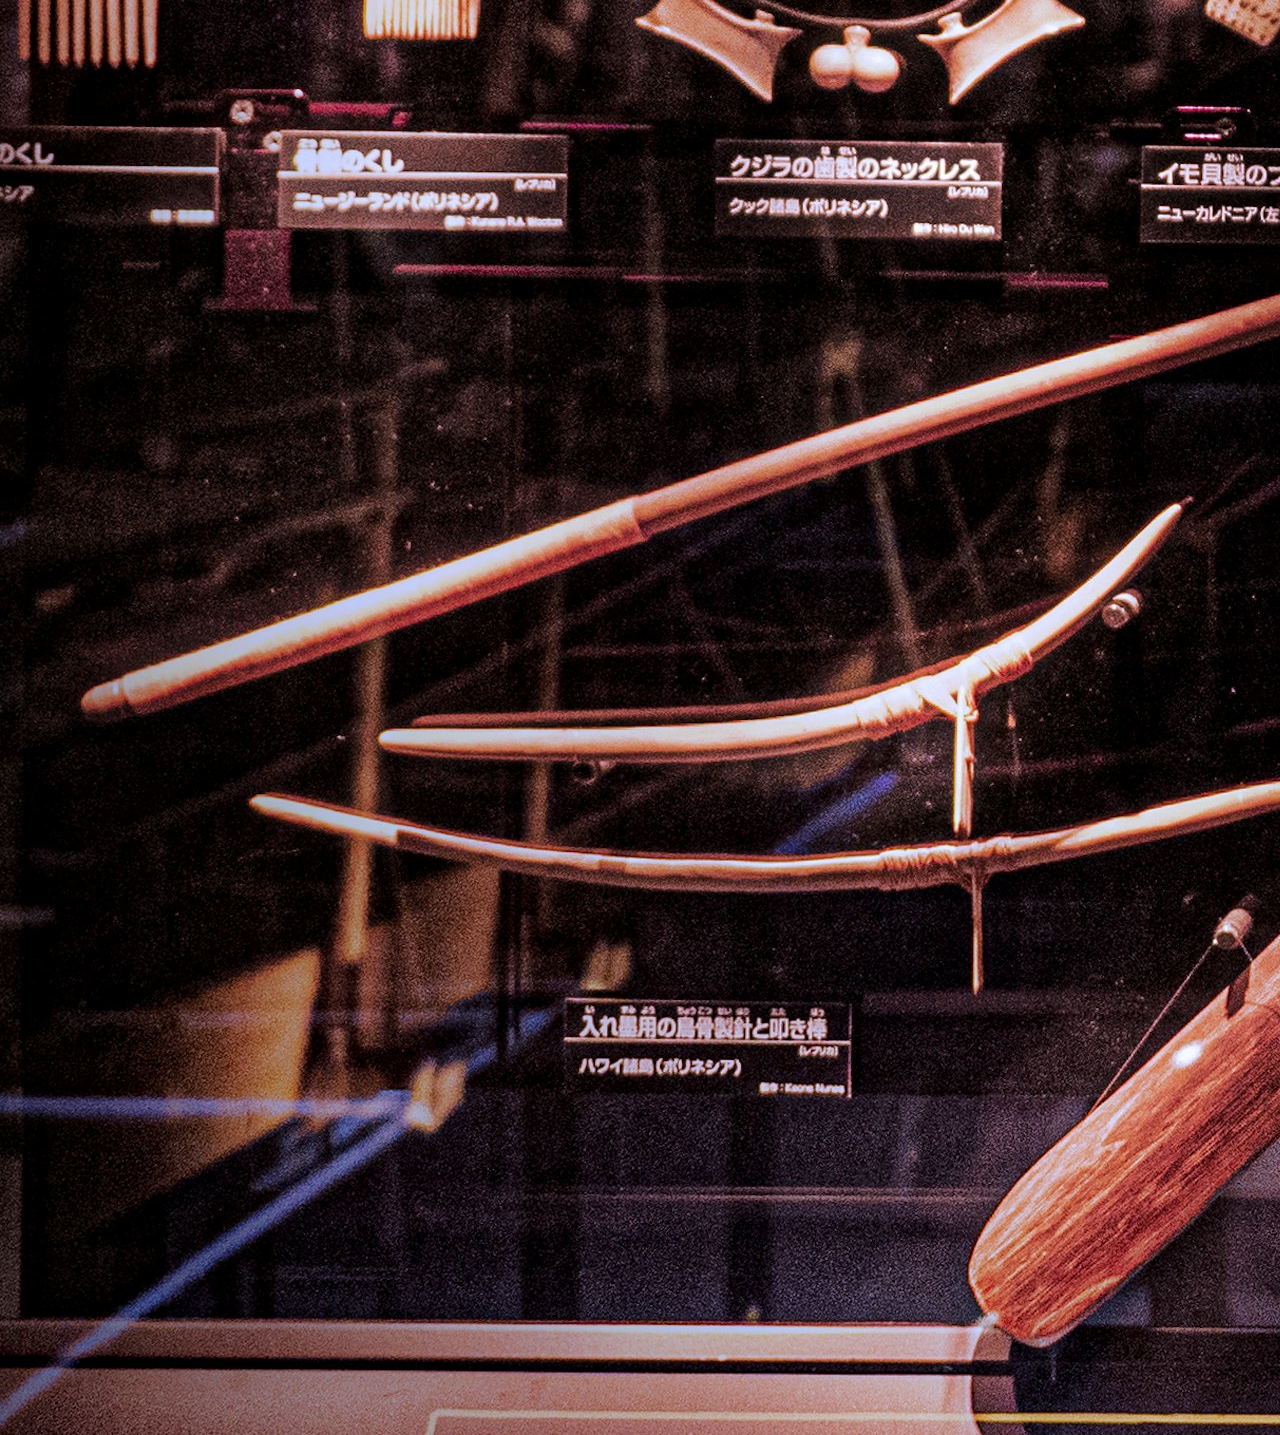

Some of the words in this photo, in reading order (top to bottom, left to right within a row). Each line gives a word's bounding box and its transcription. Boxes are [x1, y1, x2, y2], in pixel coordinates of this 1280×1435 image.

[293, 148, 405, 173] のくし
[731, 154, 981, 181] クジラの歯製のネックレス
[579, 1015, 828, 1040] 入れ墨用の鳥骨製針と叩き棒
